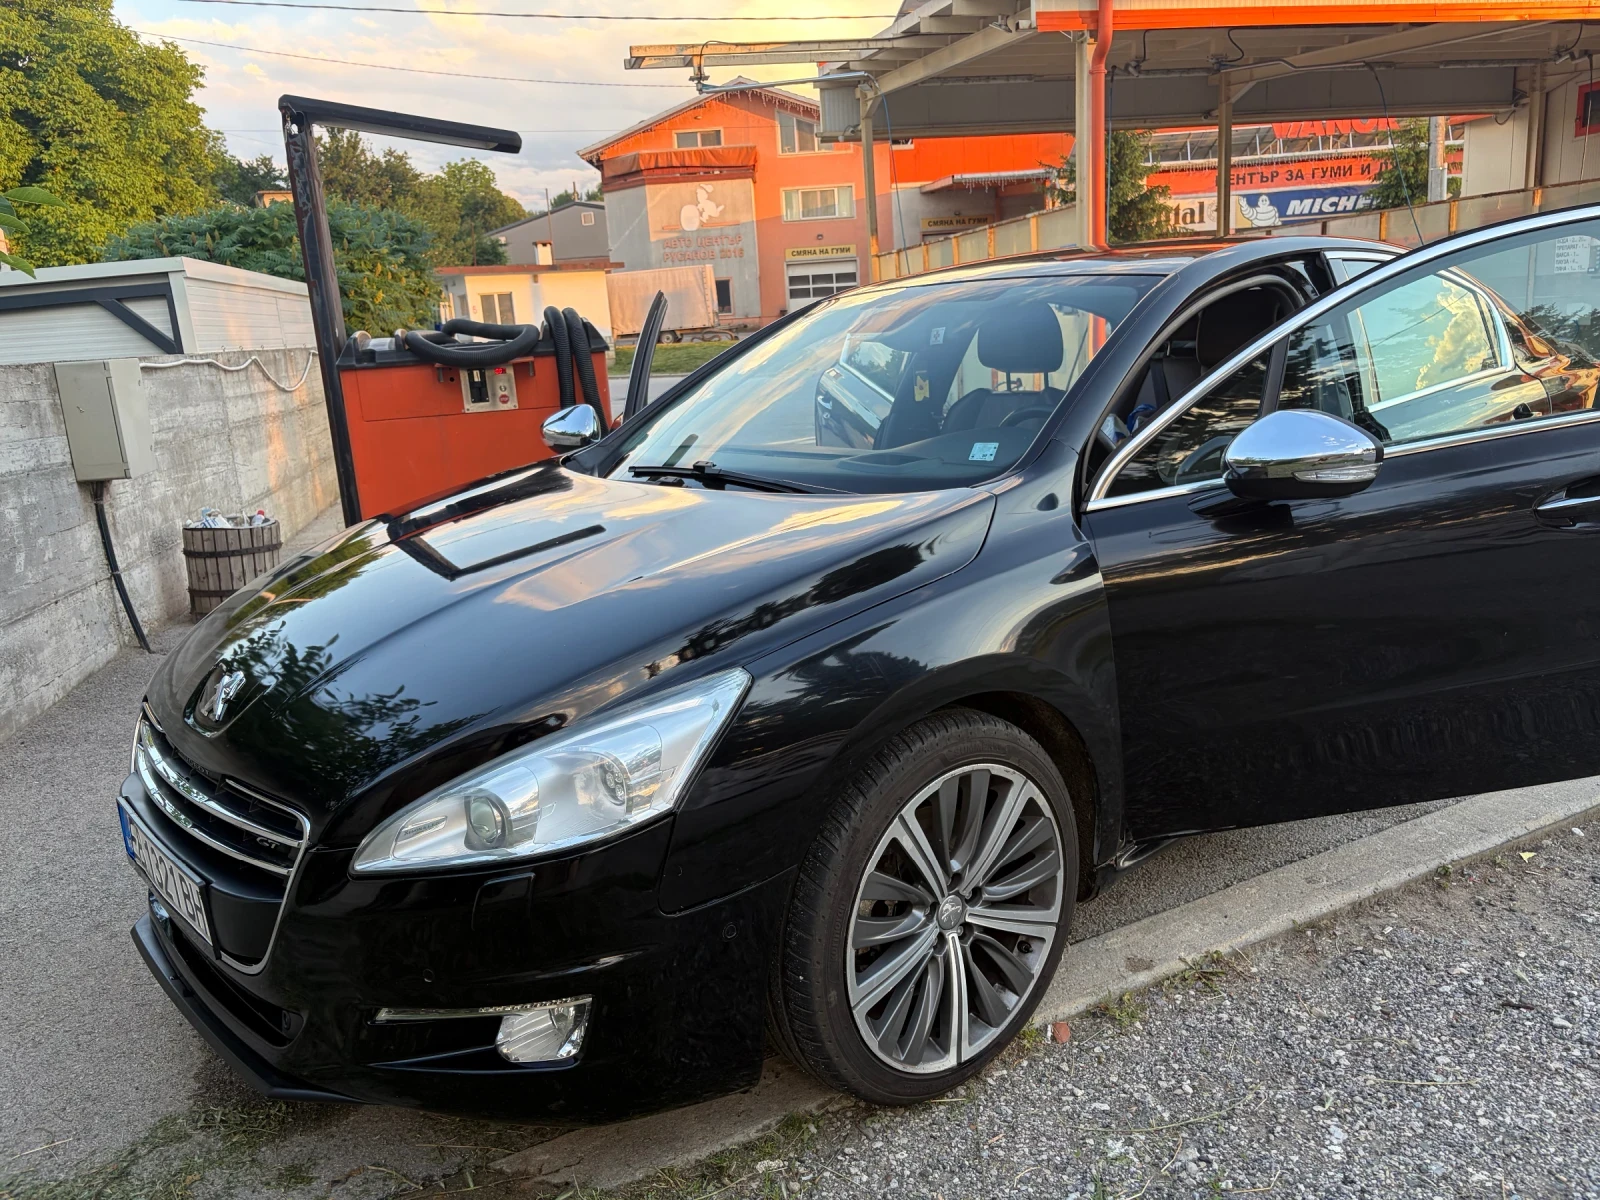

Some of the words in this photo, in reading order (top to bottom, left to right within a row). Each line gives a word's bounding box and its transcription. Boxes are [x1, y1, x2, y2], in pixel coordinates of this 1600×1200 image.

[1216, 170, 1280, 187] ЕНТЪР
[1285, 168, 1304, 182] ЗА
[1311, 164, 1353, 180] ГУМИ
[1360, 162, 1371, 176] И
[927, 219, 954, 228] СМЯНА
[967, 217, 988, 225] ГУМИ
[663, 236, 694, 250] АВТО
[696, 232, 744, 249] ЦЕНТЪР
[663, 248, 717, 263] РУСАНОВ
[720, 247, 745, 259] 2016
[791, 248, 818, 257] СМЯНА
[818, 247, 830, 255] НА
[830, 246, 852, 255] ГУМИ
[256, 837, 281, 849] GT
